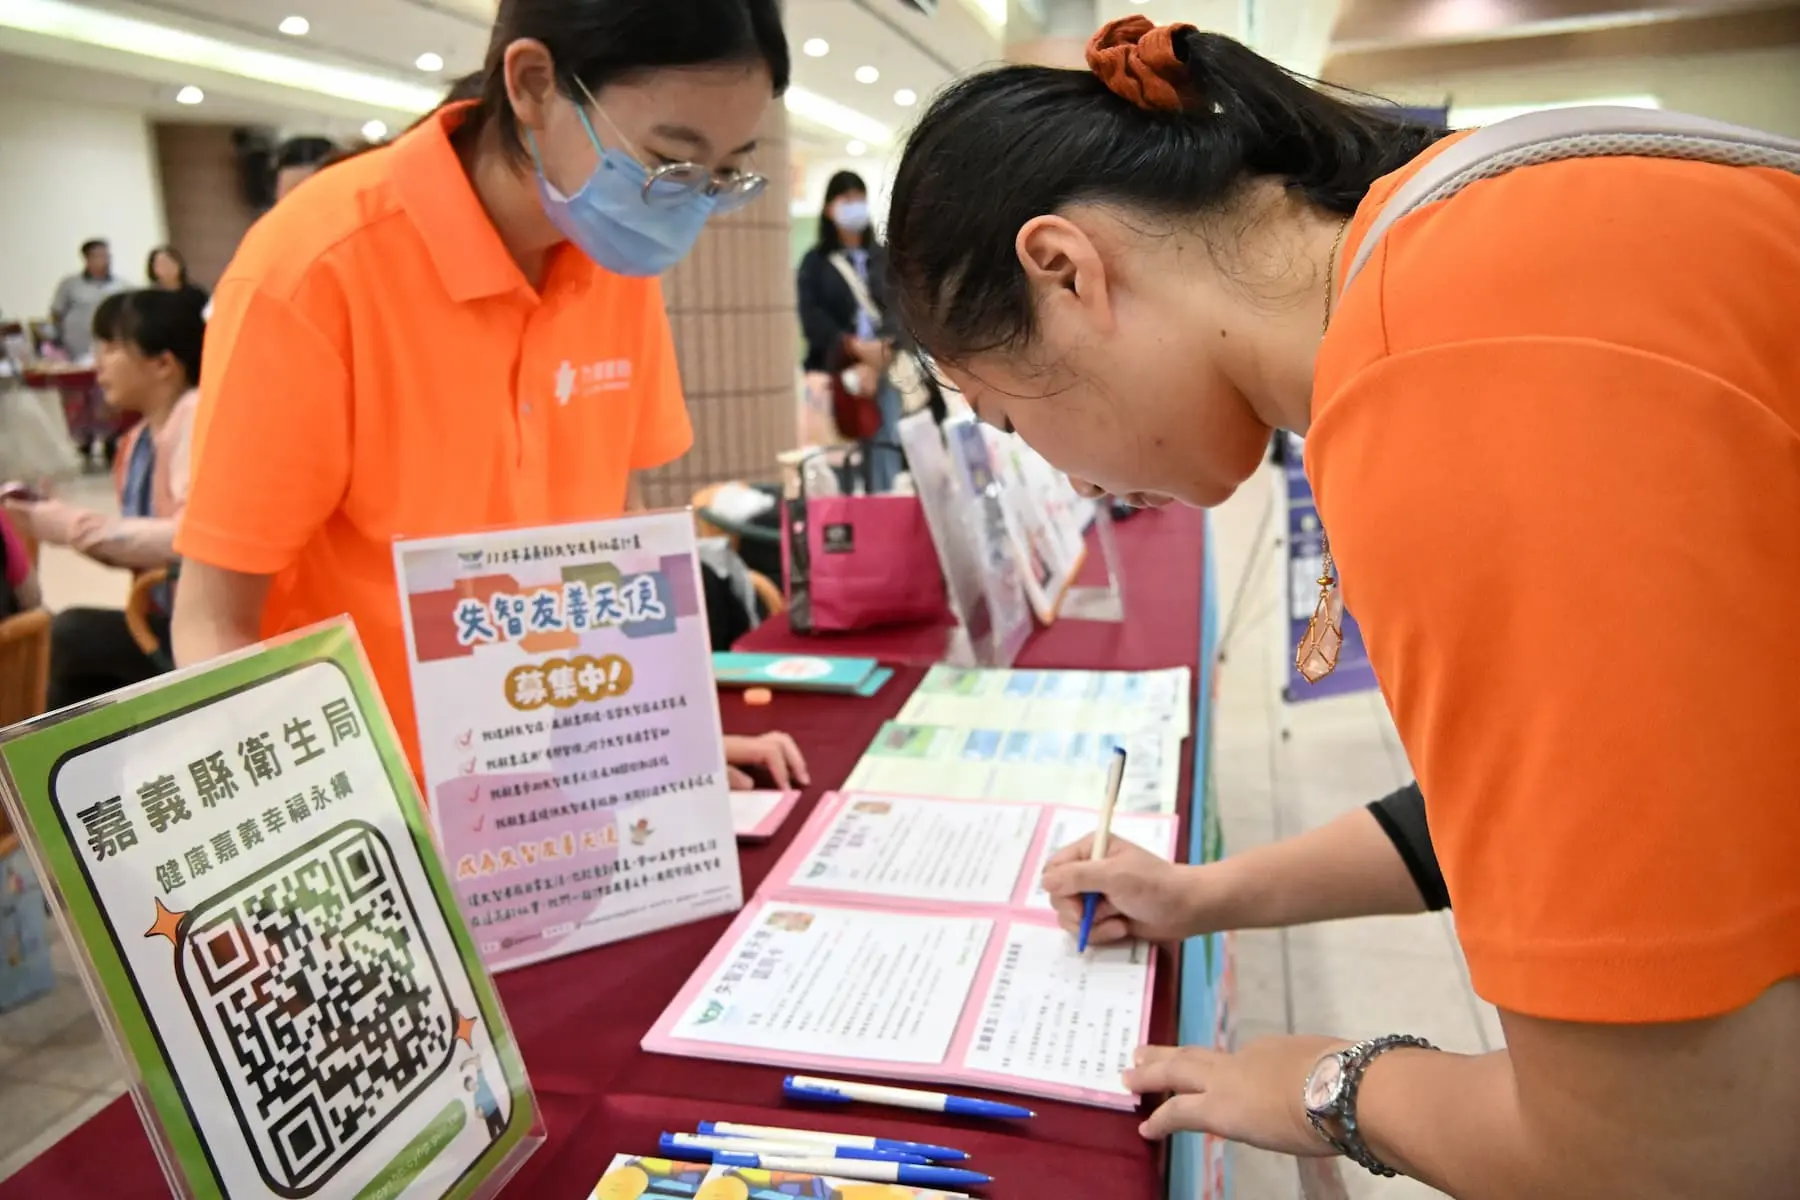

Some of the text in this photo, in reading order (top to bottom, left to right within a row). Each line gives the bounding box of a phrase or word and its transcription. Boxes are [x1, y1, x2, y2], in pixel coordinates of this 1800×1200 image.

[458, 577, 665, 642] 失智友善天使
[76, 697, 361, 861] 嘉義縣衛生局
[156, 771, 353, 894] 健康嘉義幸福永續
[458, 825, 619, 880] 成為失智友善天使
